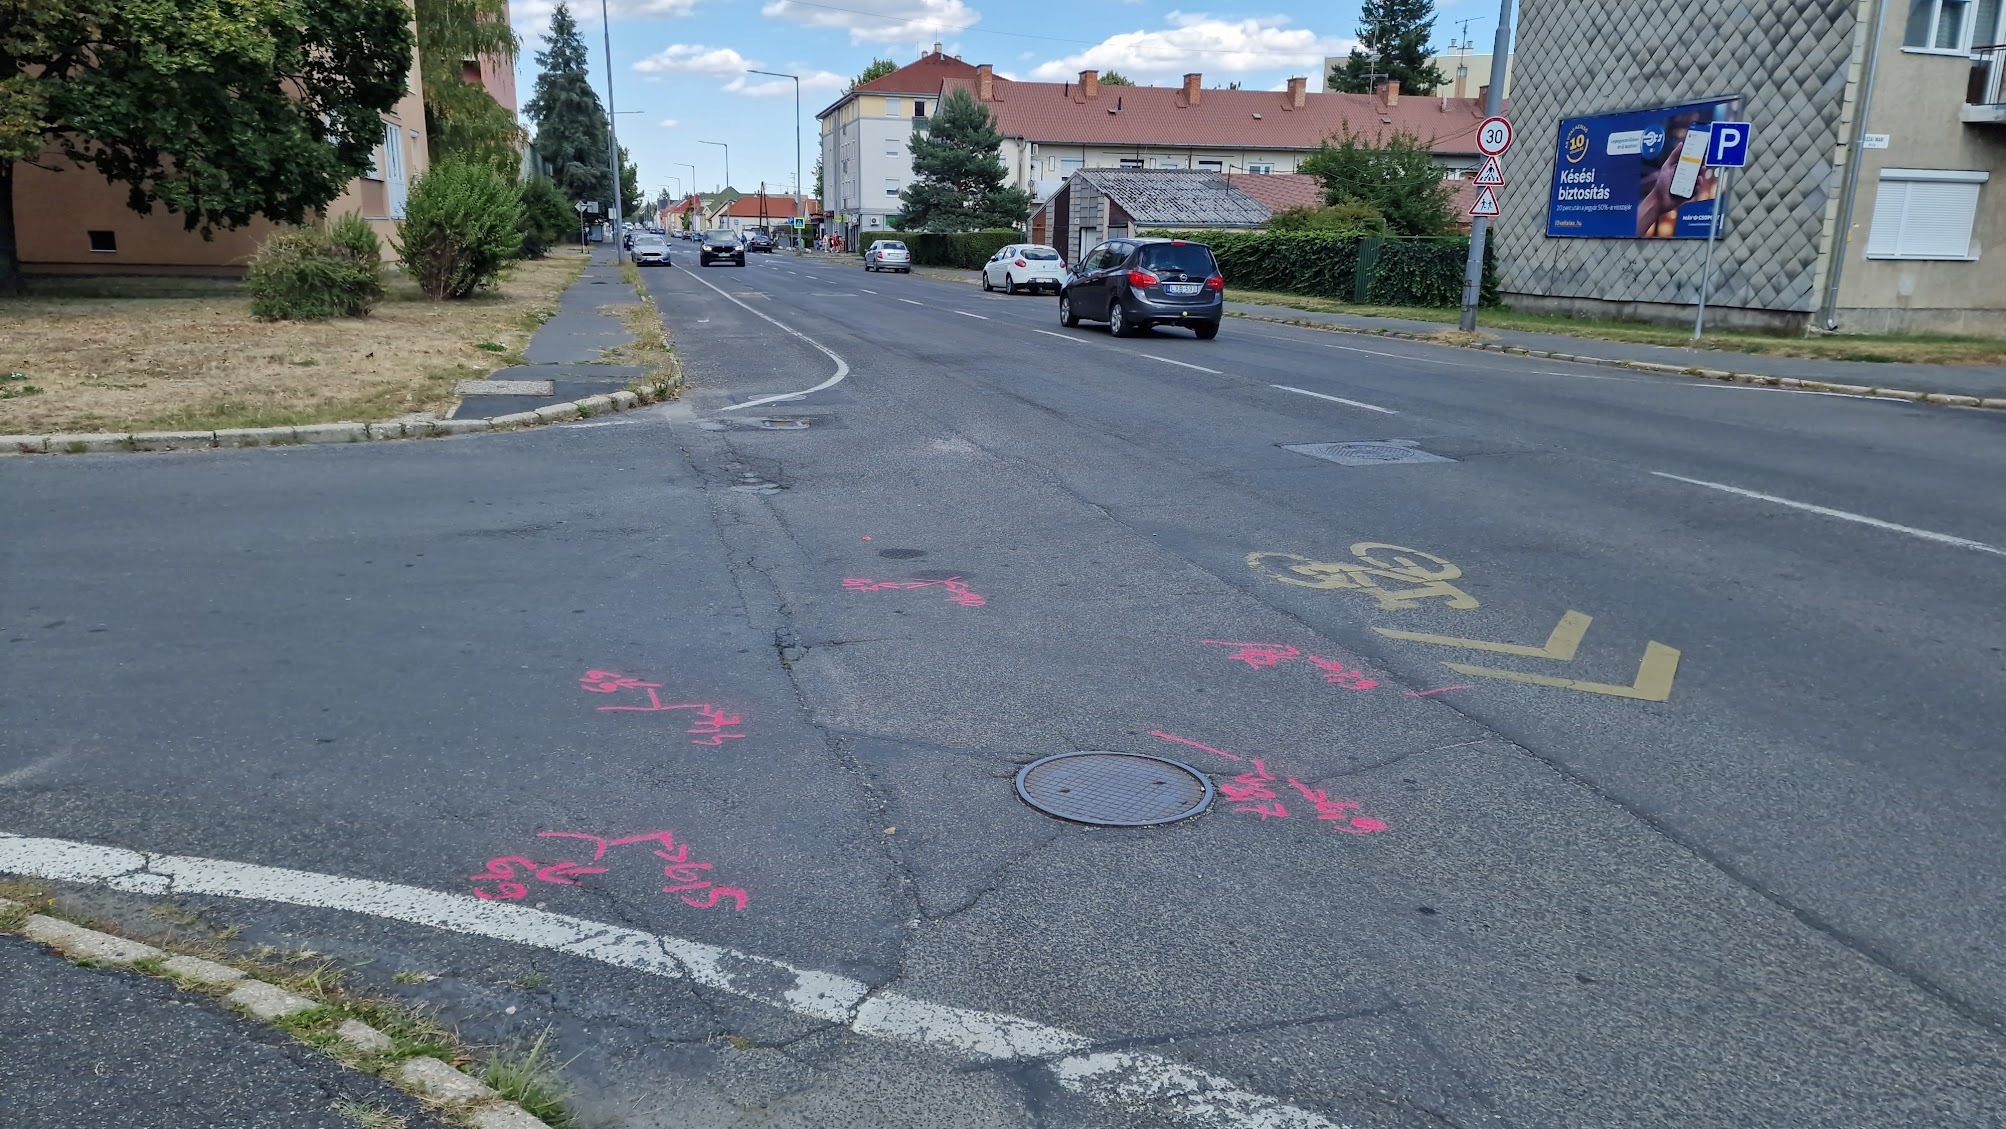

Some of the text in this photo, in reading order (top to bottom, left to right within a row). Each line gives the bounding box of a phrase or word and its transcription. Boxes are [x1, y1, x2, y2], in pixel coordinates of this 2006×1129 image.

[1486, 129, 1503, 144] 30
[1570, 134, 1585, 149] 10
[1717, 128, 1741, 160] P
[1560, 168, 1595, 184] Késési
[1558, 184, 1611, 201] biztosítás
